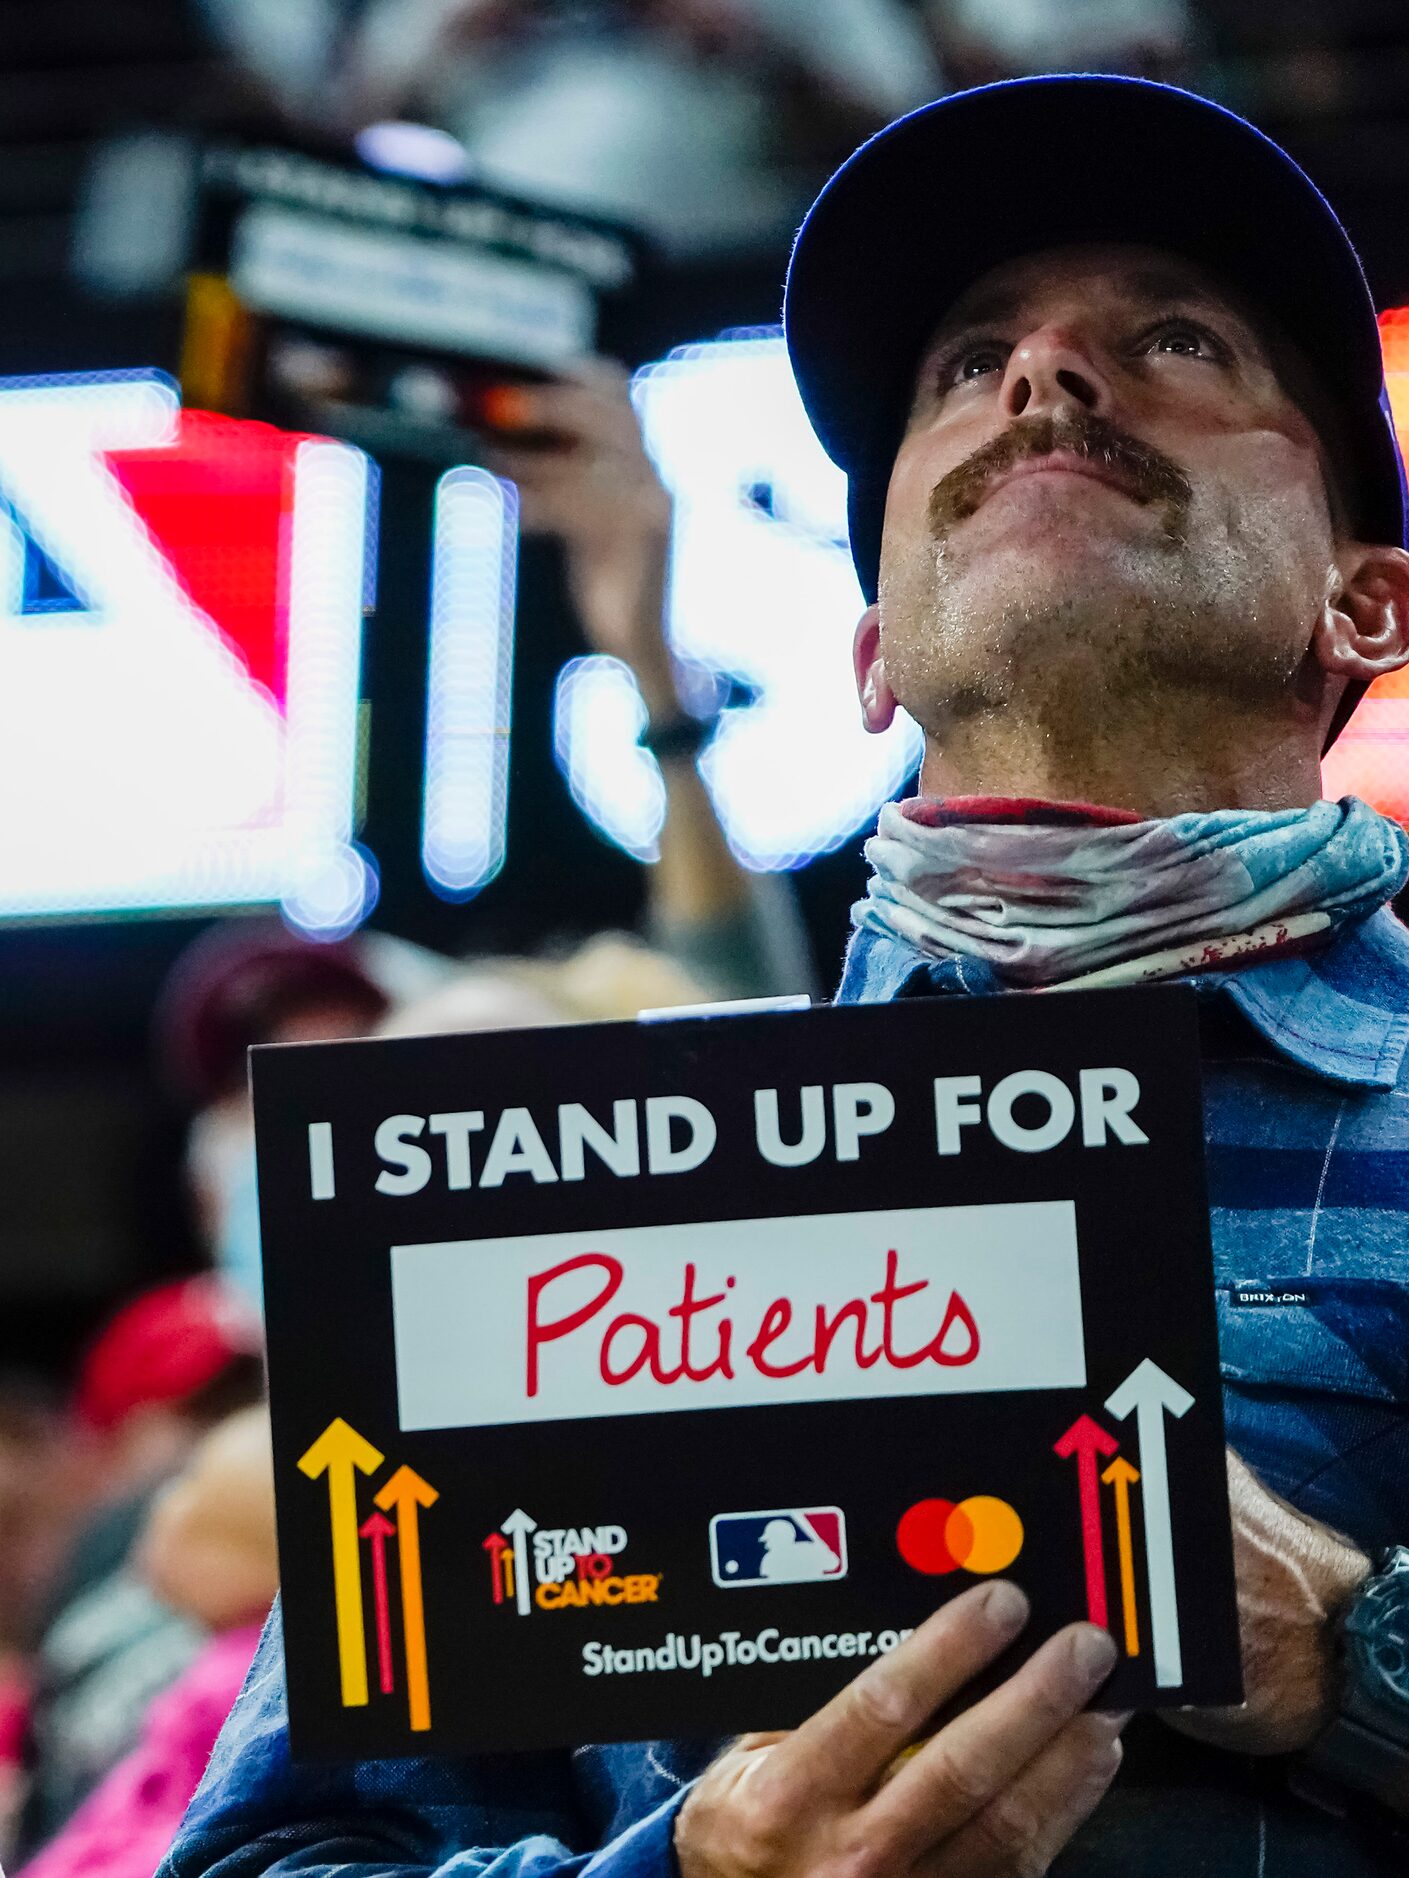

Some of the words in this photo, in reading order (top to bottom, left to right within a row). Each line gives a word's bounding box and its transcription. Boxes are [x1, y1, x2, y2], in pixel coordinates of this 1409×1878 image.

[309, 1122, 335, 1199] I
[375, 1096, 716, 1196] STAND
[755, 1083, 894, 1166] UP
[934, 1068, 1149, 1154] FOR
[527, 1250, 979, 1397] Patients
[533, 1525, 628, 1558] STAND
[535, 1555, 576, 1584] UP
[574, 1553, 613, 1582] TO
[535, 1574, 659, 1610] CANCER
[582, 1628, 913, 1677] StandUpToCancer.or
